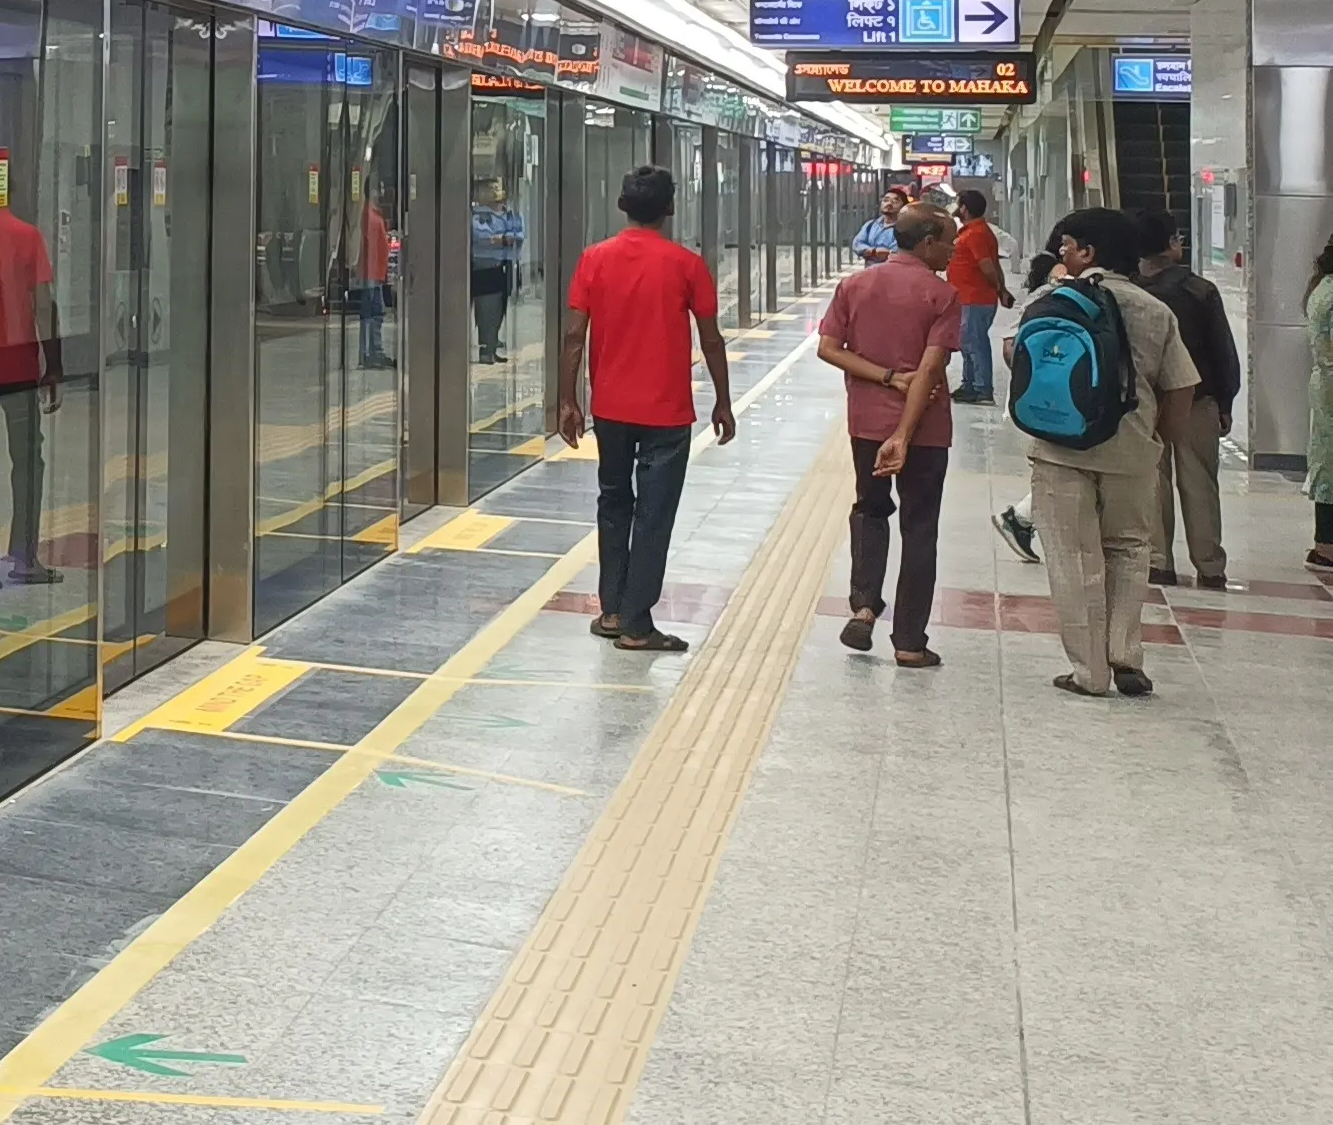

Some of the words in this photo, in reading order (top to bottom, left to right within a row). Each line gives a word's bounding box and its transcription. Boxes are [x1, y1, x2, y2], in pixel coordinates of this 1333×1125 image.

[863, 31, 886, 43] Lift
[888, 31, 896, 43] 1
[996, 62, 1015, 76] 02
[827, 78, 916, 94] WELCOME
[921, 79, 945, 93] TO
[949, 79, 1029, 95] MAHAKA
